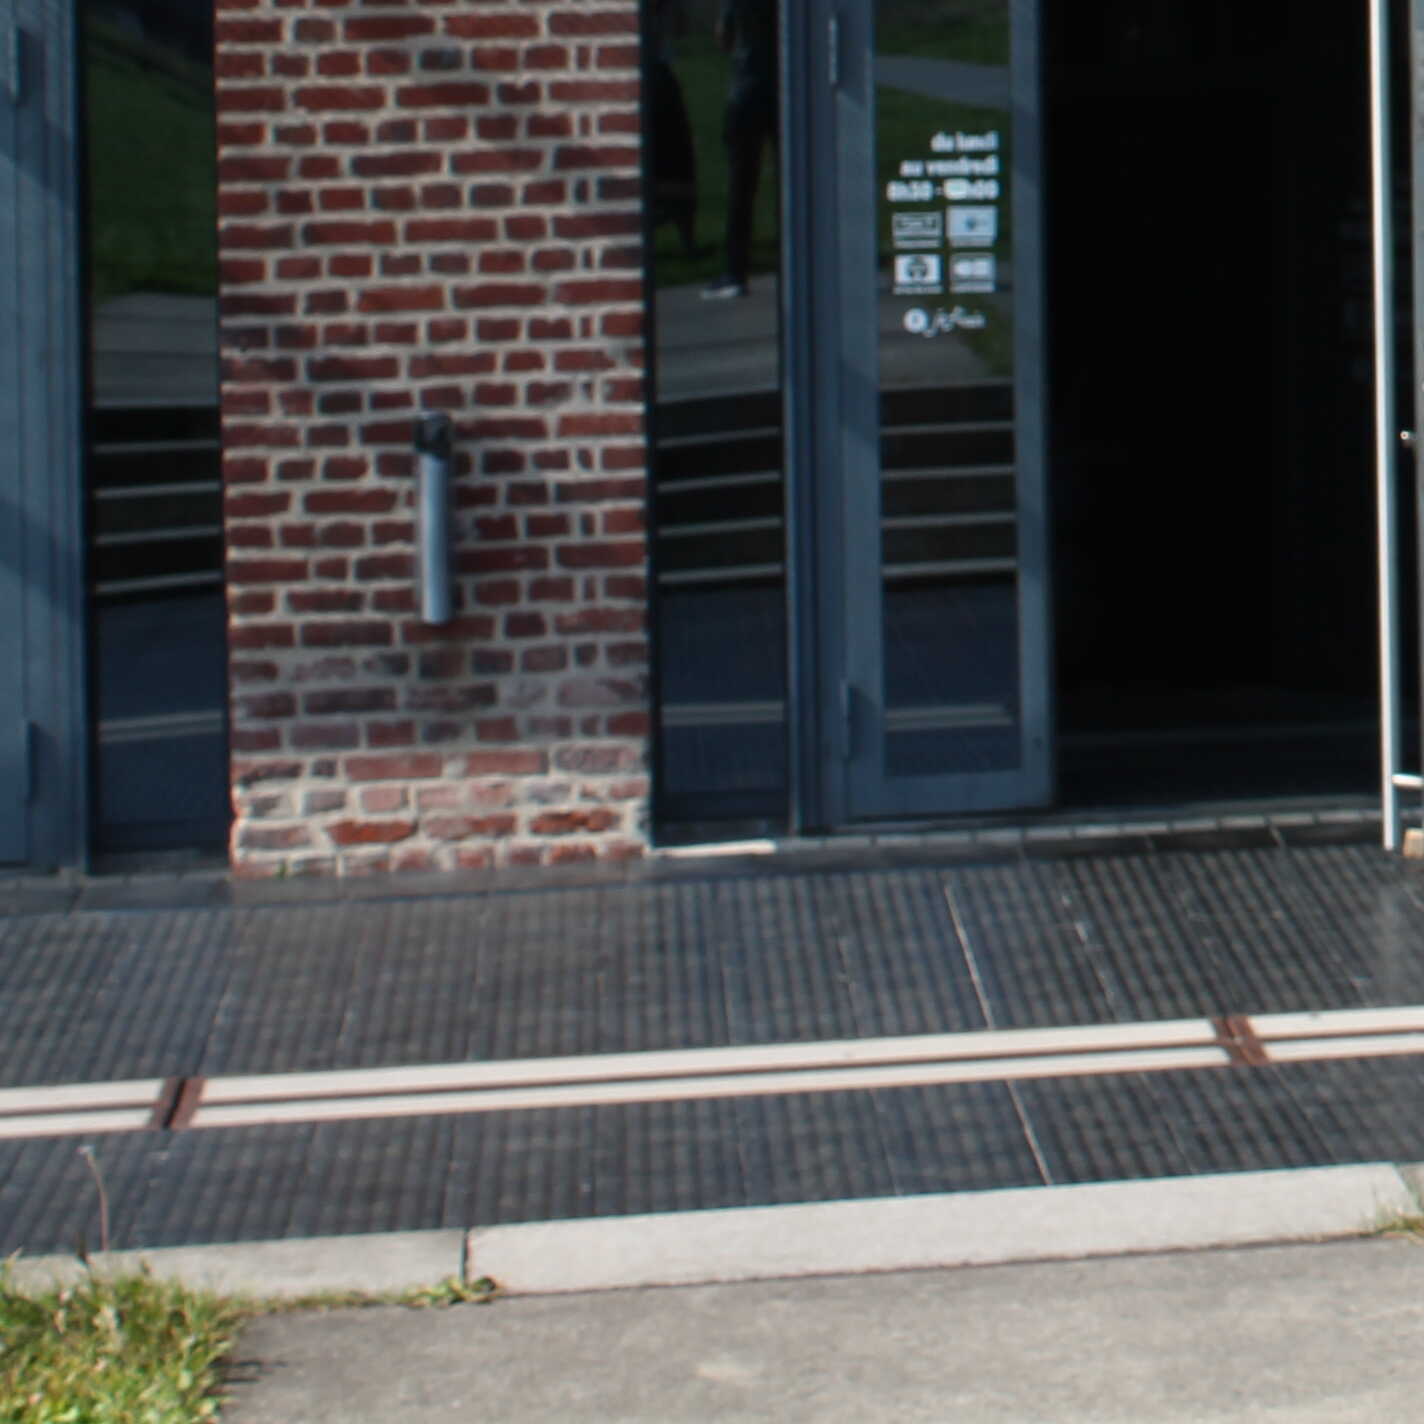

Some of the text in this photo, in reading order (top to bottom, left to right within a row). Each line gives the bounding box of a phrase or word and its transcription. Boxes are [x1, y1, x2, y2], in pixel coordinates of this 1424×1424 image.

[931, 130, 999, 153] du lundi
[926, 154, 999, 176] vendredi
